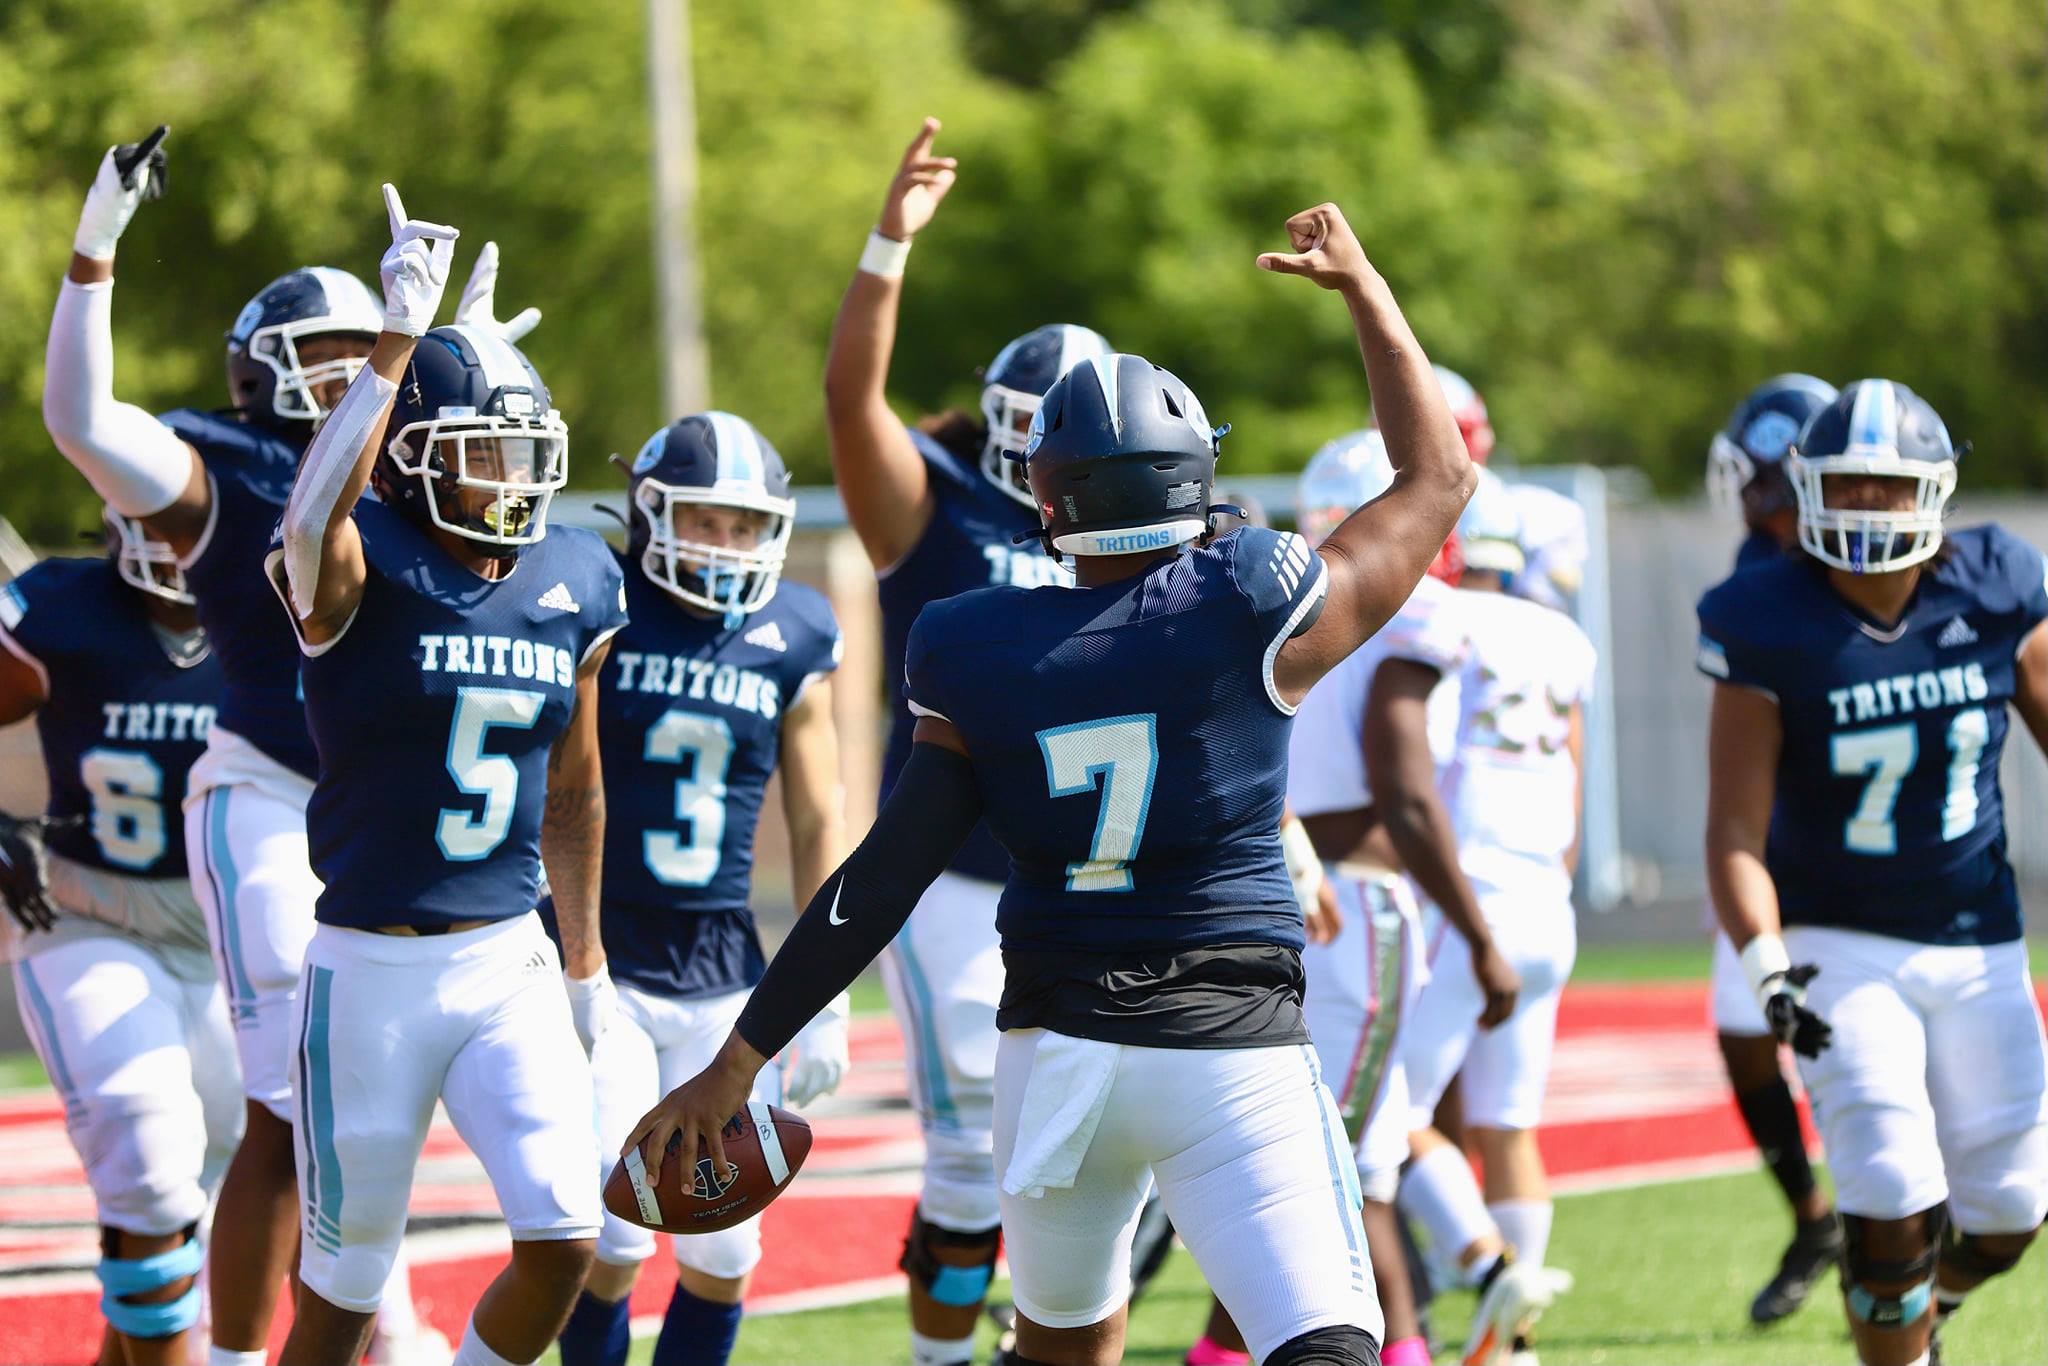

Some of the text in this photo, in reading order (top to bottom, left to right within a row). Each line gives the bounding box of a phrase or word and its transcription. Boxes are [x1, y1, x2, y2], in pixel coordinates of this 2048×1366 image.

[1096, 530, 1170, 552] TRITONS
[418, 634, 574, 688] TRITONS
[616, 651, 780, 721] TRITONS
[1828, 662, 1989, 725] TRITONS
[80, 745, 168, 871] 6
[435, 686, 547, 862] 5
[642, 708, 737, 888] 3
[1034, 712, 1160, 892] 7
[1831, 708, 1990, 854] 71
